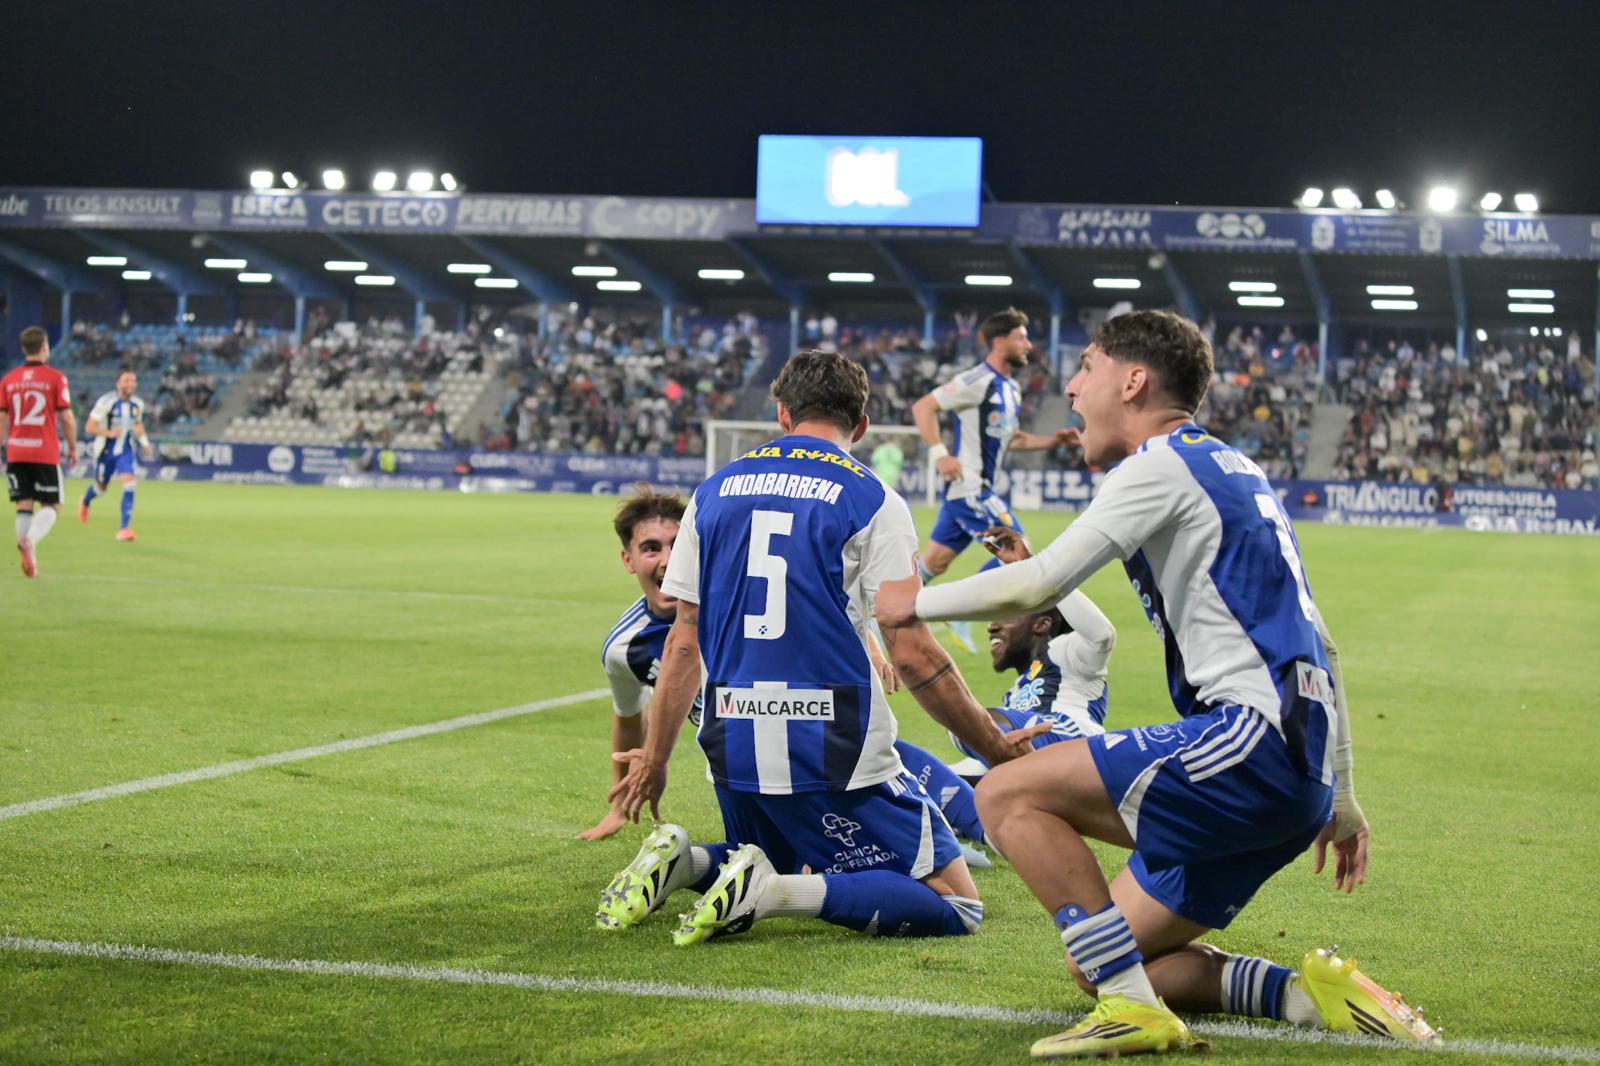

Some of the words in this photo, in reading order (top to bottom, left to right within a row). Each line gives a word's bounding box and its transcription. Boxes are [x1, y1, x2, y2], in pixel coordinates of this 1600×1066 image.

[1483, 219, 1549, 242] SILMA
[12, 390, 46, 426] 12
[743, 447, 781, 458] AJA
[719, 472, 844, 505] UNDABARRENA
[743, 509, 794, 640] 5
[737, 700, 830, 716] VALCARCE
[918, 765, 932, 785] DP
